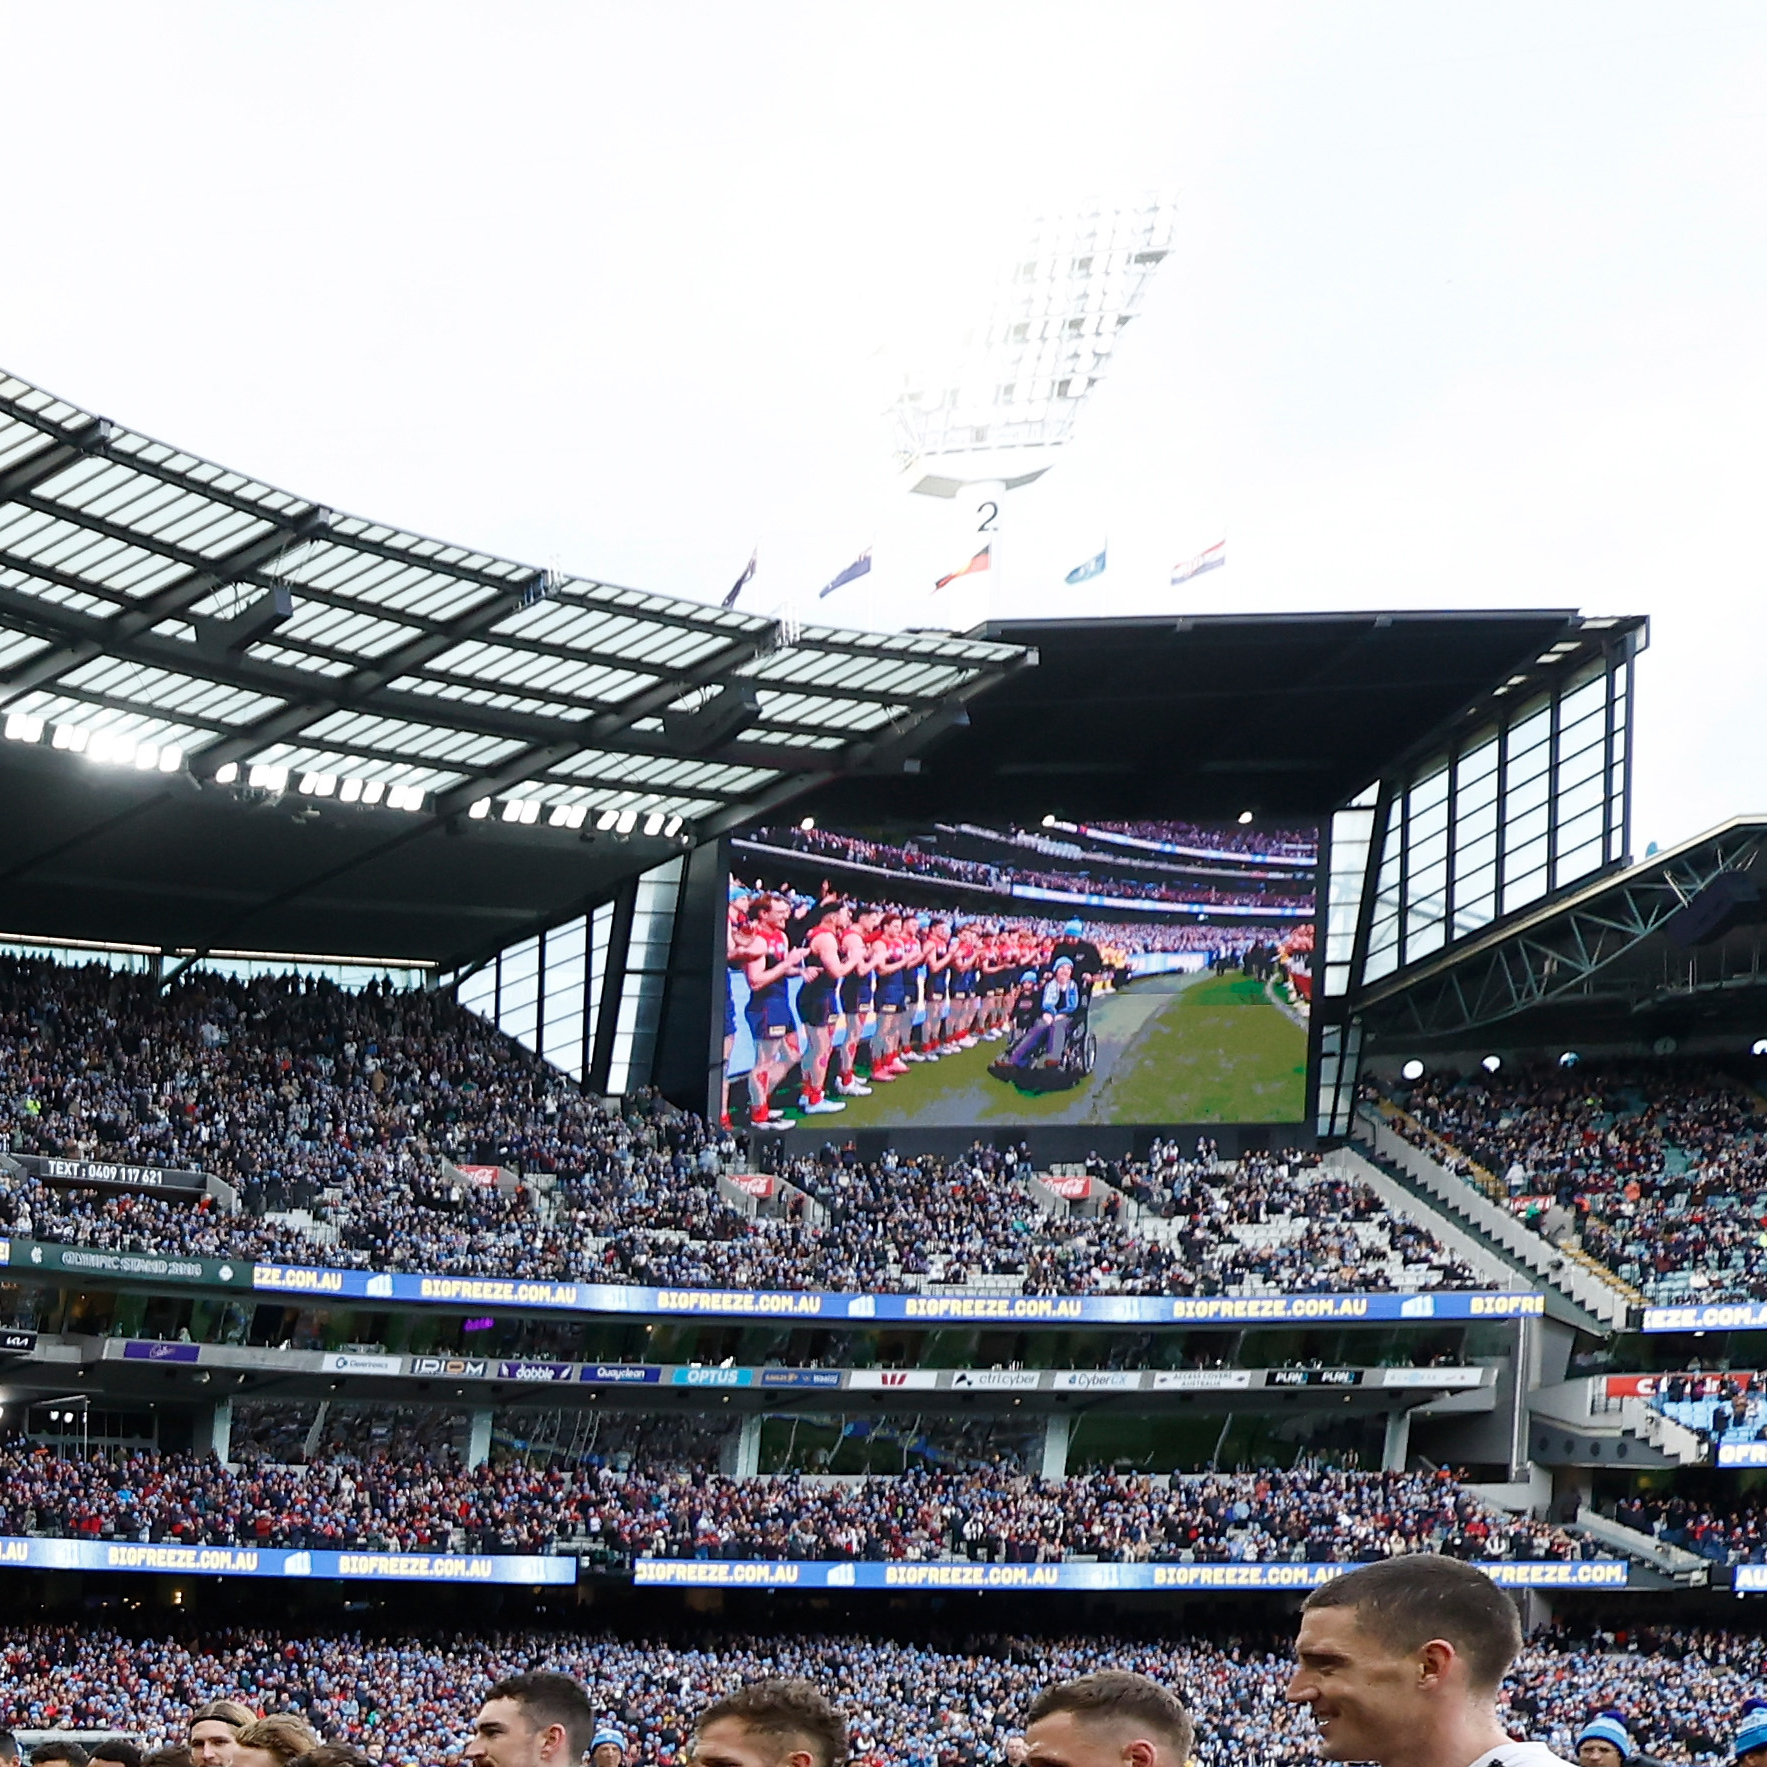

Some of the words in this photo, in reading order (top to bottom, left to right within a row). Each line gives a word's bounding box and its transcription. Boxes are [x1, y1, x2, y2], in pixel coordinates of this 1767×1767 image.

[976, 501, 999, 532] 2
[48, 1158, 78, 1177] TEXT
[88, 1163, 118, 1181] 0409
[119, 1166, 140, 1184] 117
[141, 1168, 164, 1186] 621
[61, 1250, 120, 1270] OLYMPIC
[120, 1257, 167, 1275] STAND
[421, 1279, 576, 1305] BIGFREEZE.COM.AU
[657, 1290, 821, 1317] BIGFREEZE.COM.AU
[905, 1296, 1082, 1318] BIGFREEZE.COM.AU
[1172, 1297, 1368, 1318] BIGFREEZE.COM.AU
[516, 1364, 556, 1381] dabble
[596, 1366, 646, 1382] Quayclean
[686, 1369, 739, 1385] OPTUS
[108, 1546, 258, 1571] BIGFREEZE.COM.AU
[339, 1555, 492, 1578] BIGFREEZE.COM.AU
[885, 1566, 1059, 1587] BIGFREEZE.COM.AU
